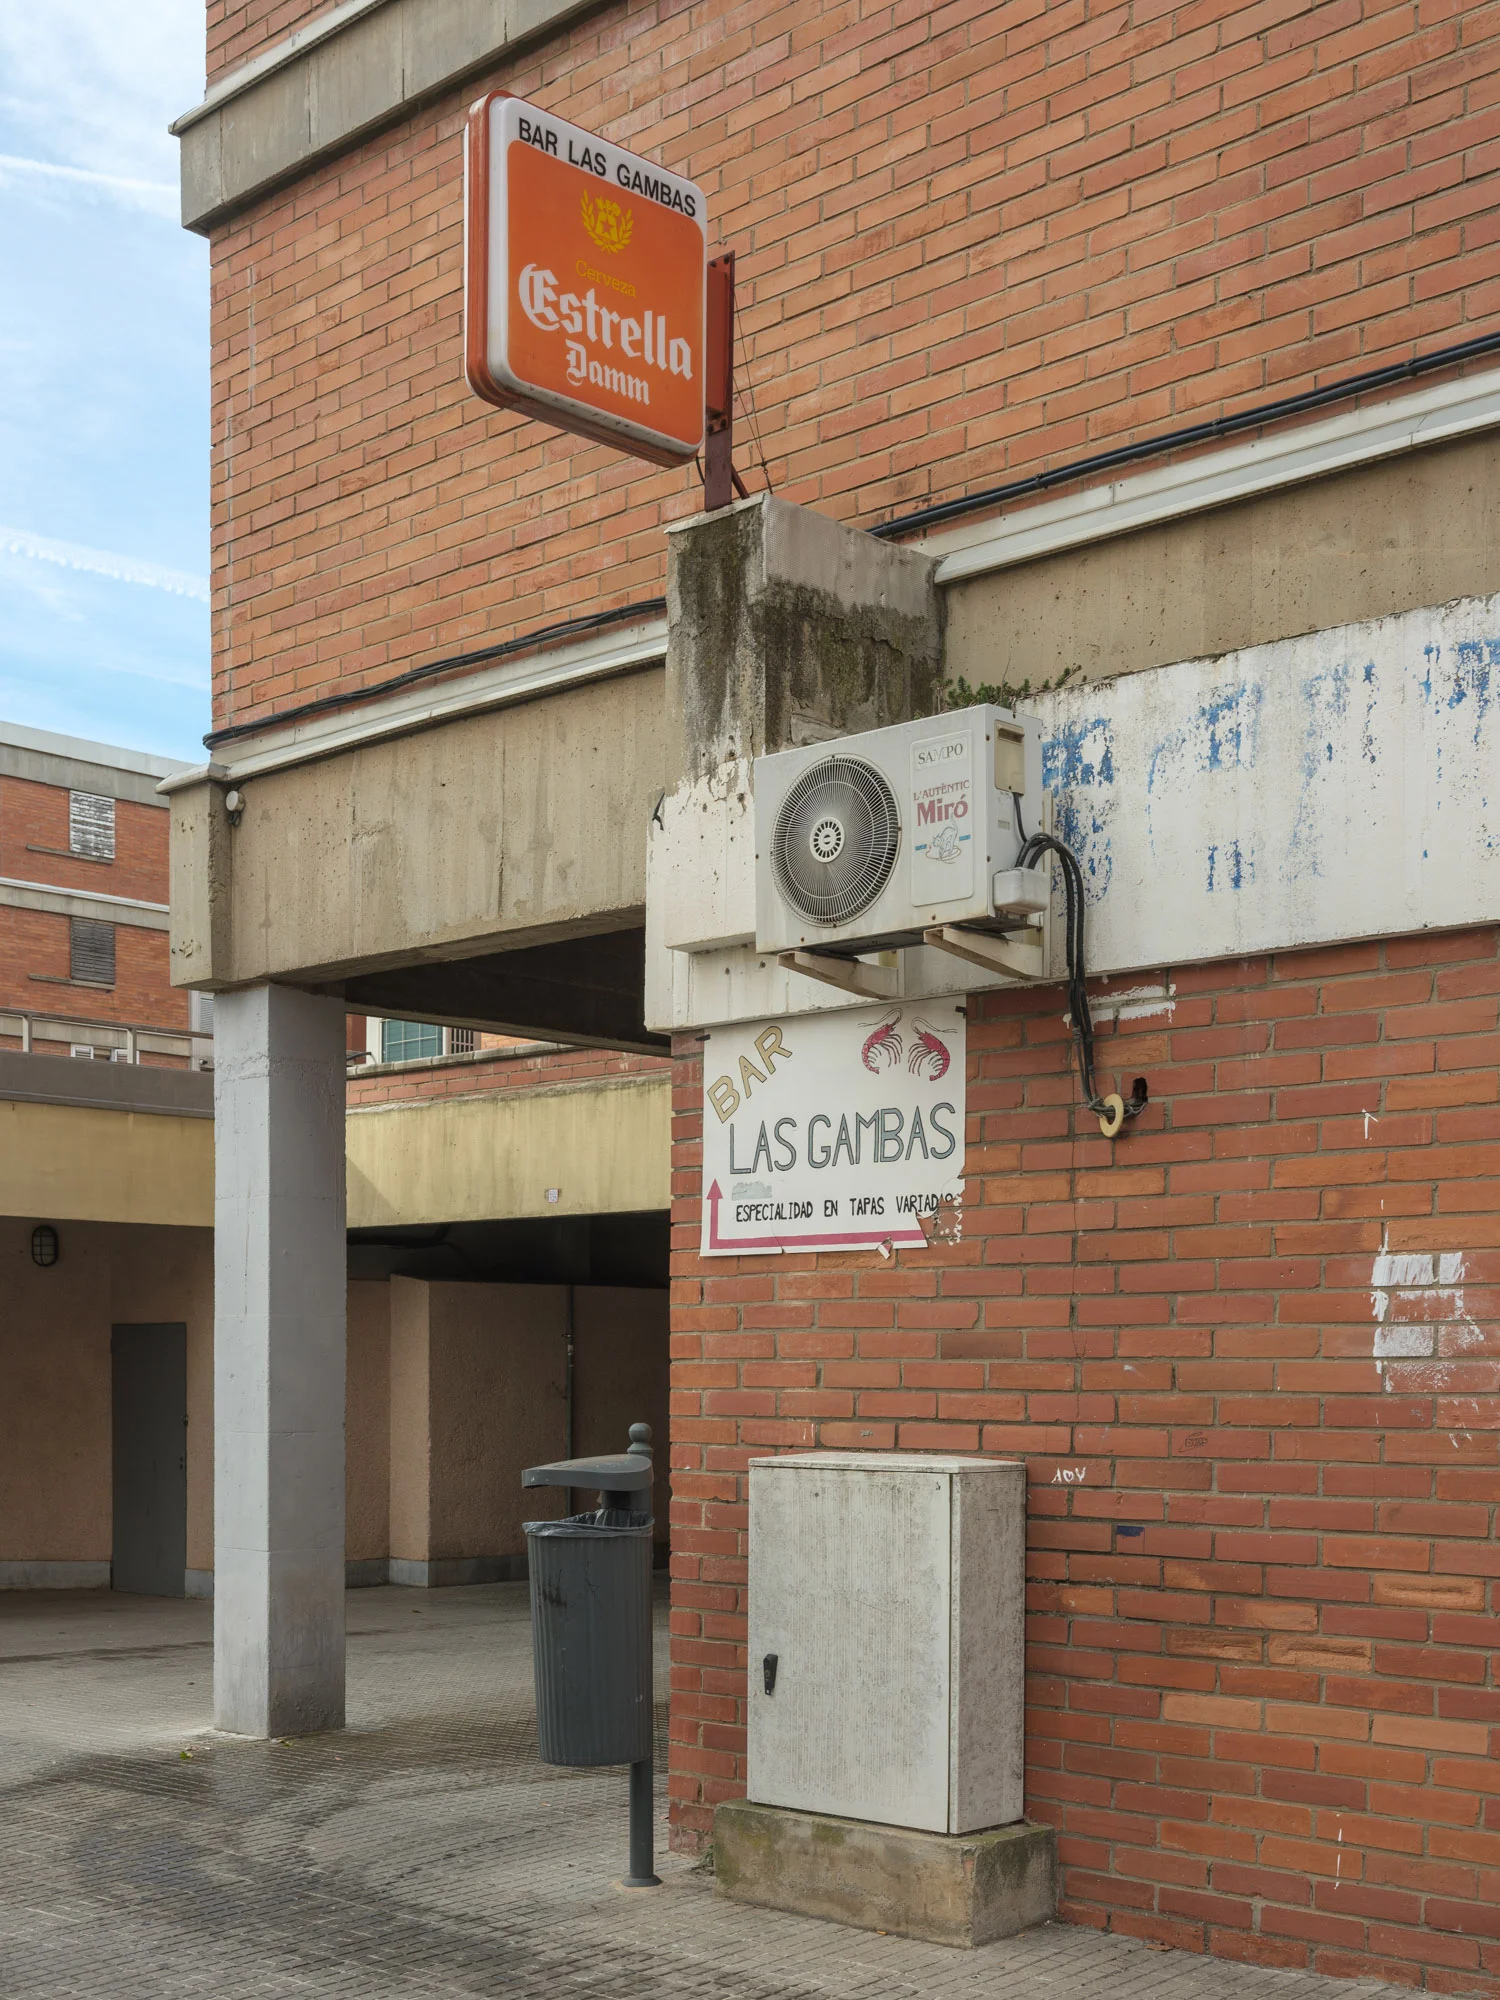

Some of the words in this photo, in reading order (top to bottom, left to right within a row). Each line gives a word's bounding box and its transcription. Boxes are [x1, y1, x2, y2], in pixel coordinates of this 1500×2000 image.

[518, 117, 558, 156] BAR
[568, 140, 606, 176] LAS
[616, 163, 696, 217] GAMBAS
[575, 259, 637, 298] Cerveza
[518, 263, 693, 380] Estrella
[566, 339, 650, 405] Damm
[917, 794, 968, 826] Miró
[707, 1026, 792, 1124] BAR
[730, 1117, 797, 1174] LAS
[808, 1102, 955, 1168] GAMBAS
[736, 1201, 813, 1222] ESPECIALIDAD
[824, 1200, 838, 1217] EN
[849, 1197, 885, 1216] TAPAS
